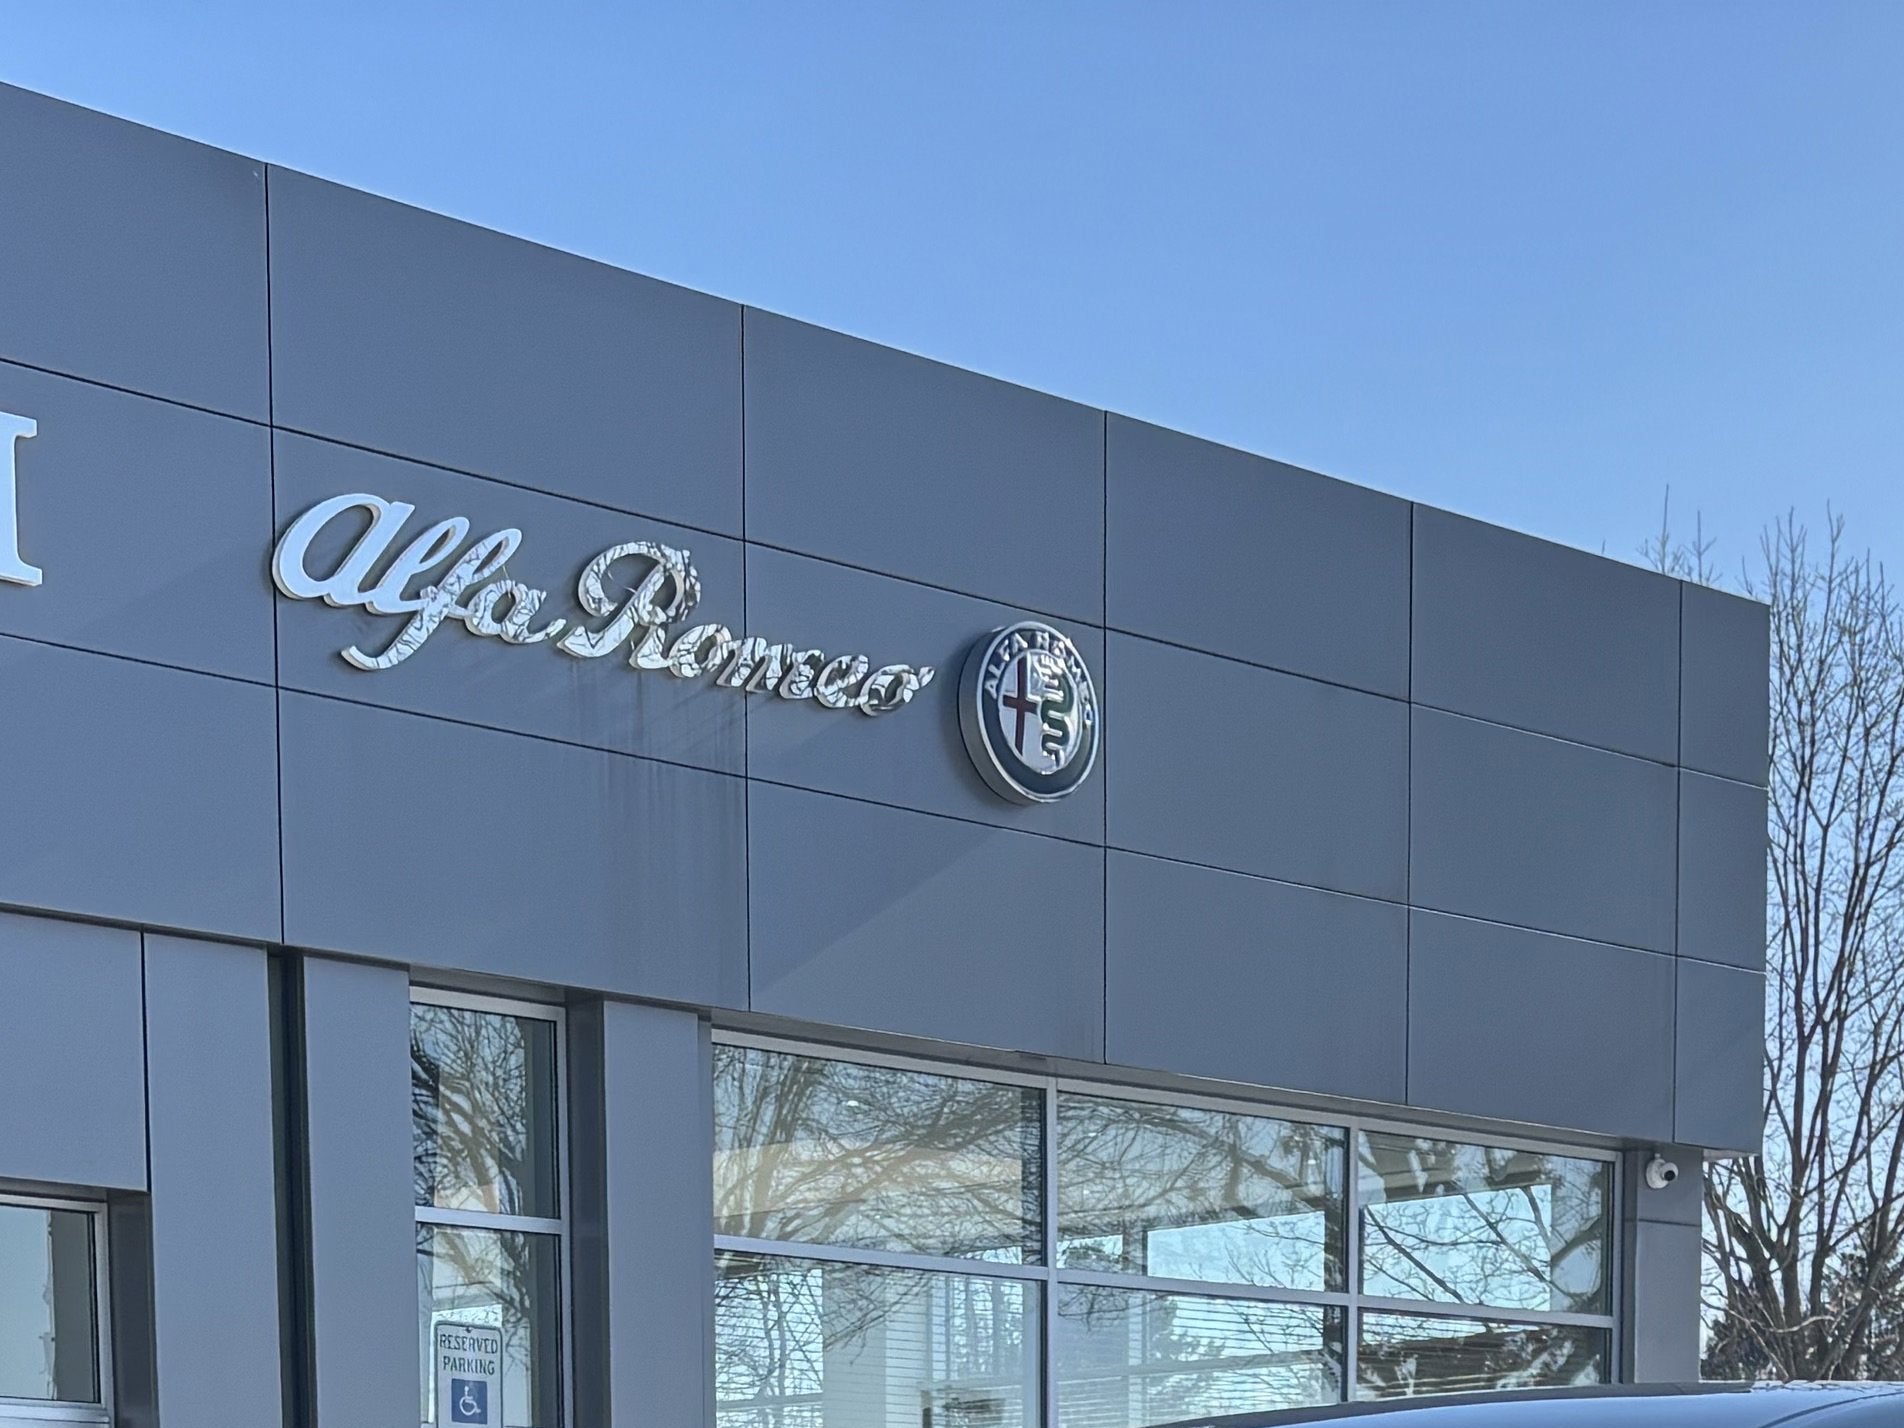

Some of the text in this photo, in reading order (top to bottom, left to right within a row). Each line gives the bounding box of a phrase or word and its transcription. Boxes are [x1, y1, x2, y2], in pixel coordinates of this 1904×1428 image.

[272, 493, 935, 716] Alfa Romeo
[440, 1334, 498, 1354] RESERVED
[443, 1355, 495, 1375] PARKING
